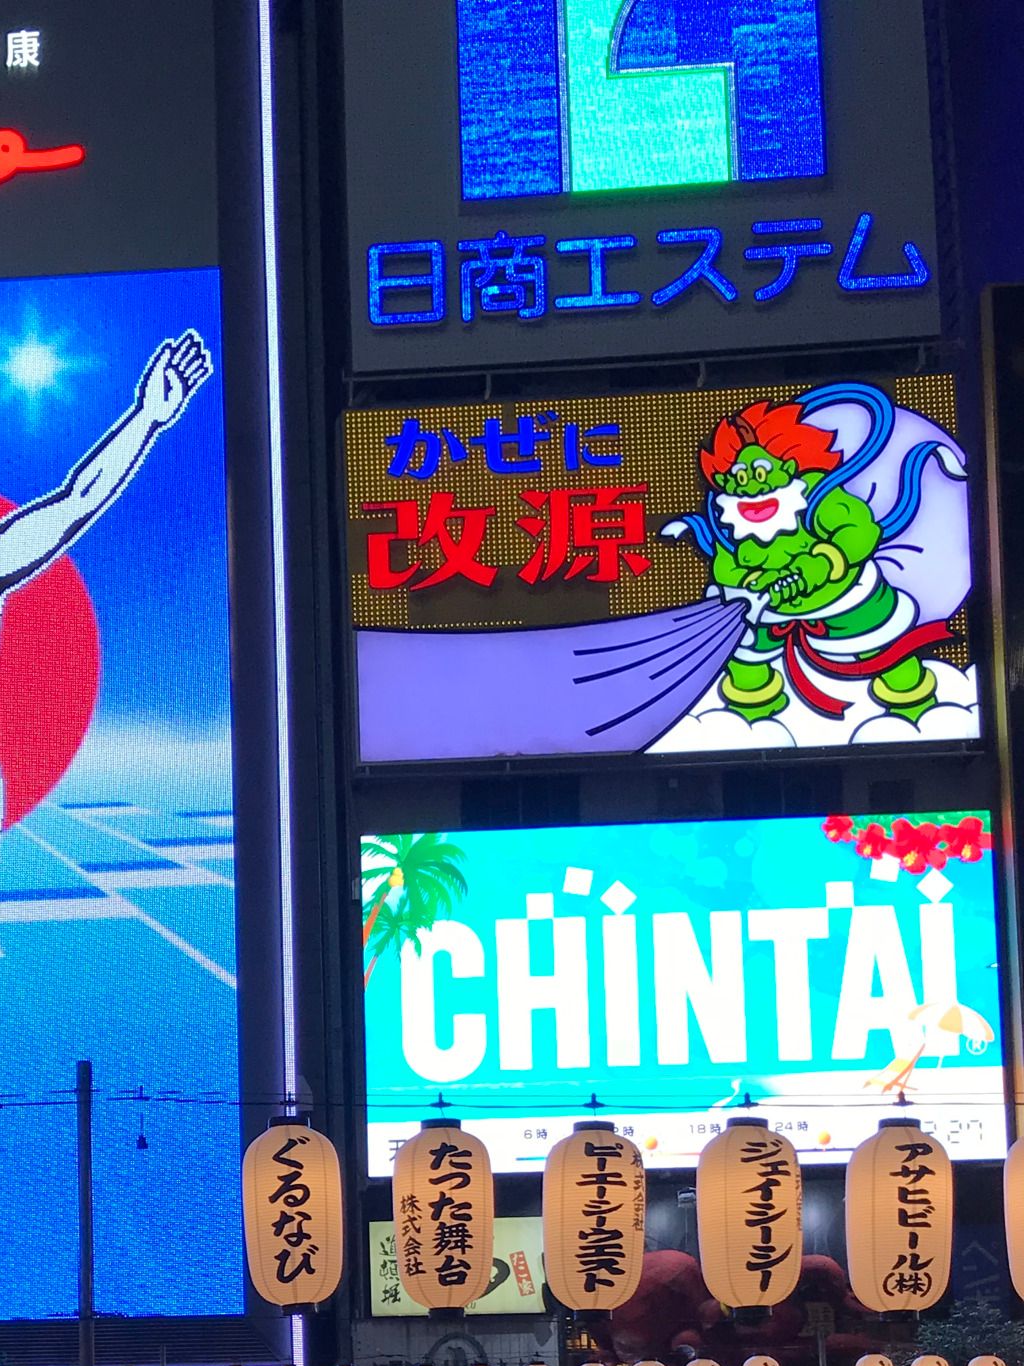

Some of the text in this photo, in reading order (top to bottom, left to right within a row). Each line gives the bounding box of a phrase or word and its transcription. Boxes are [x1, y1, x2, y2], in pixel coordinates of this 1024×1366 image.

[366, 211, 931, 327] 日商エステム
[384, 410, 623, 479] かぜに
[362, 482, 653, 592] 改源
[400, 872, 963, 1083] CHINTAI
[268, 1136, 320, 1284] ぐるなび
[399, 1193, 427, 1277] 株式会社
[428, 1141, 474, 1287] たつた舞台
